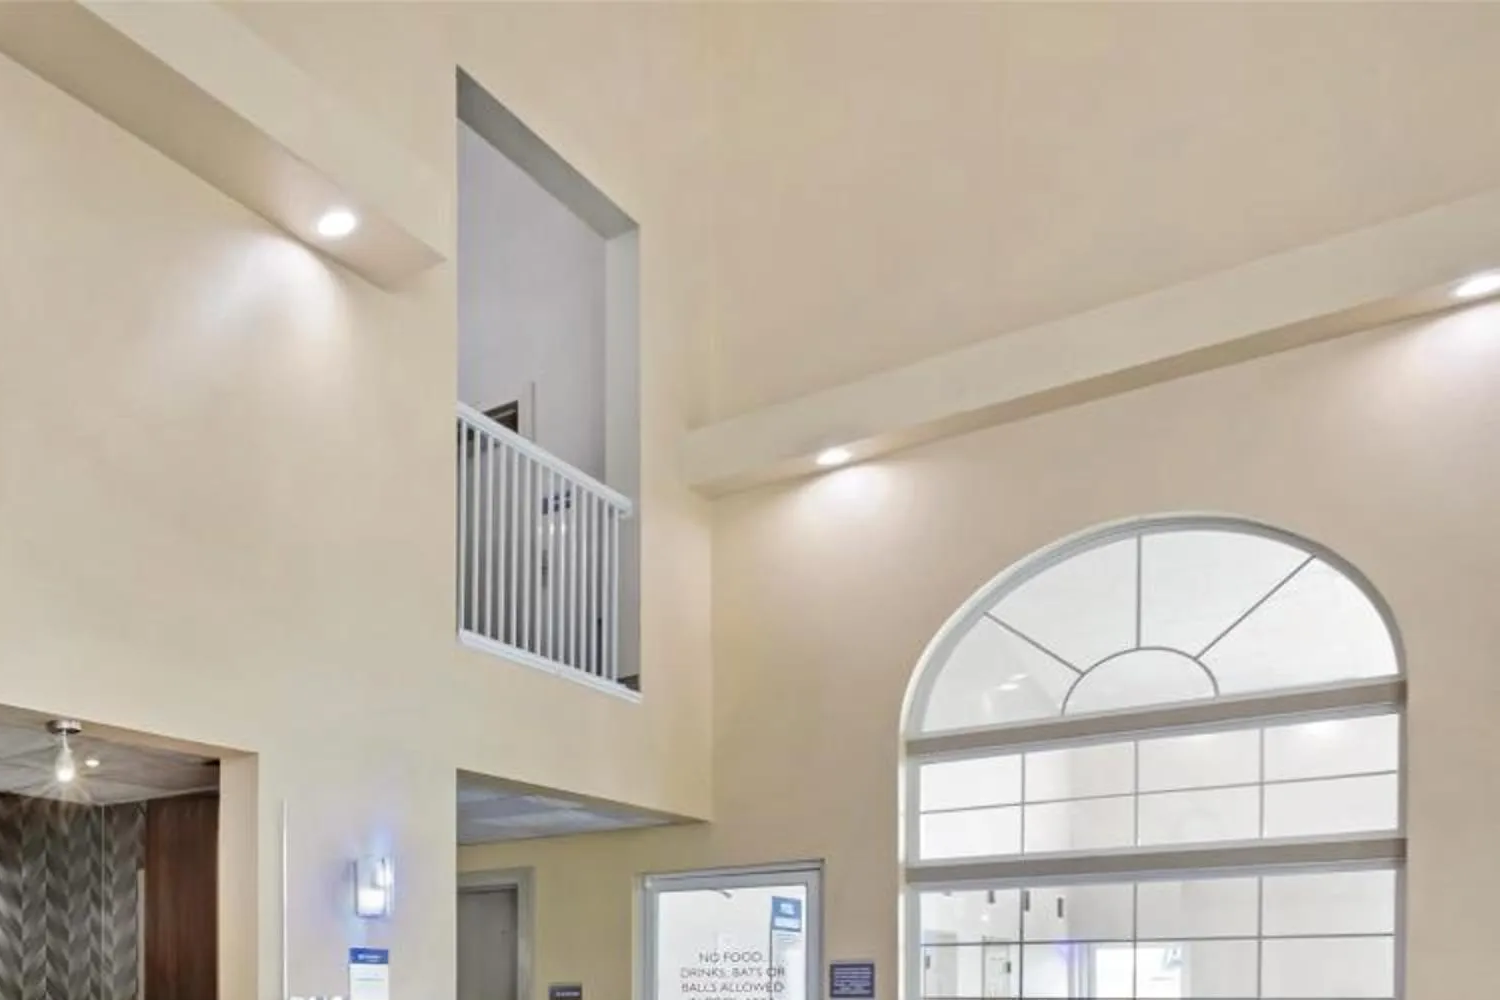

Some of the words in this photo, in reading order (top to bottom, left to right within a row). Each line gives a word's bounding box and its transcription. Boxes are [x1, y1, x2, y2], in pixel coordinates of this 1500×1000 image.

[698, 951, 721, 963] NO
[765, 966, 786, 978] OR
[681, 981, 717, 993] BALLS
[720, 981, 786, 993] ALLOWED
